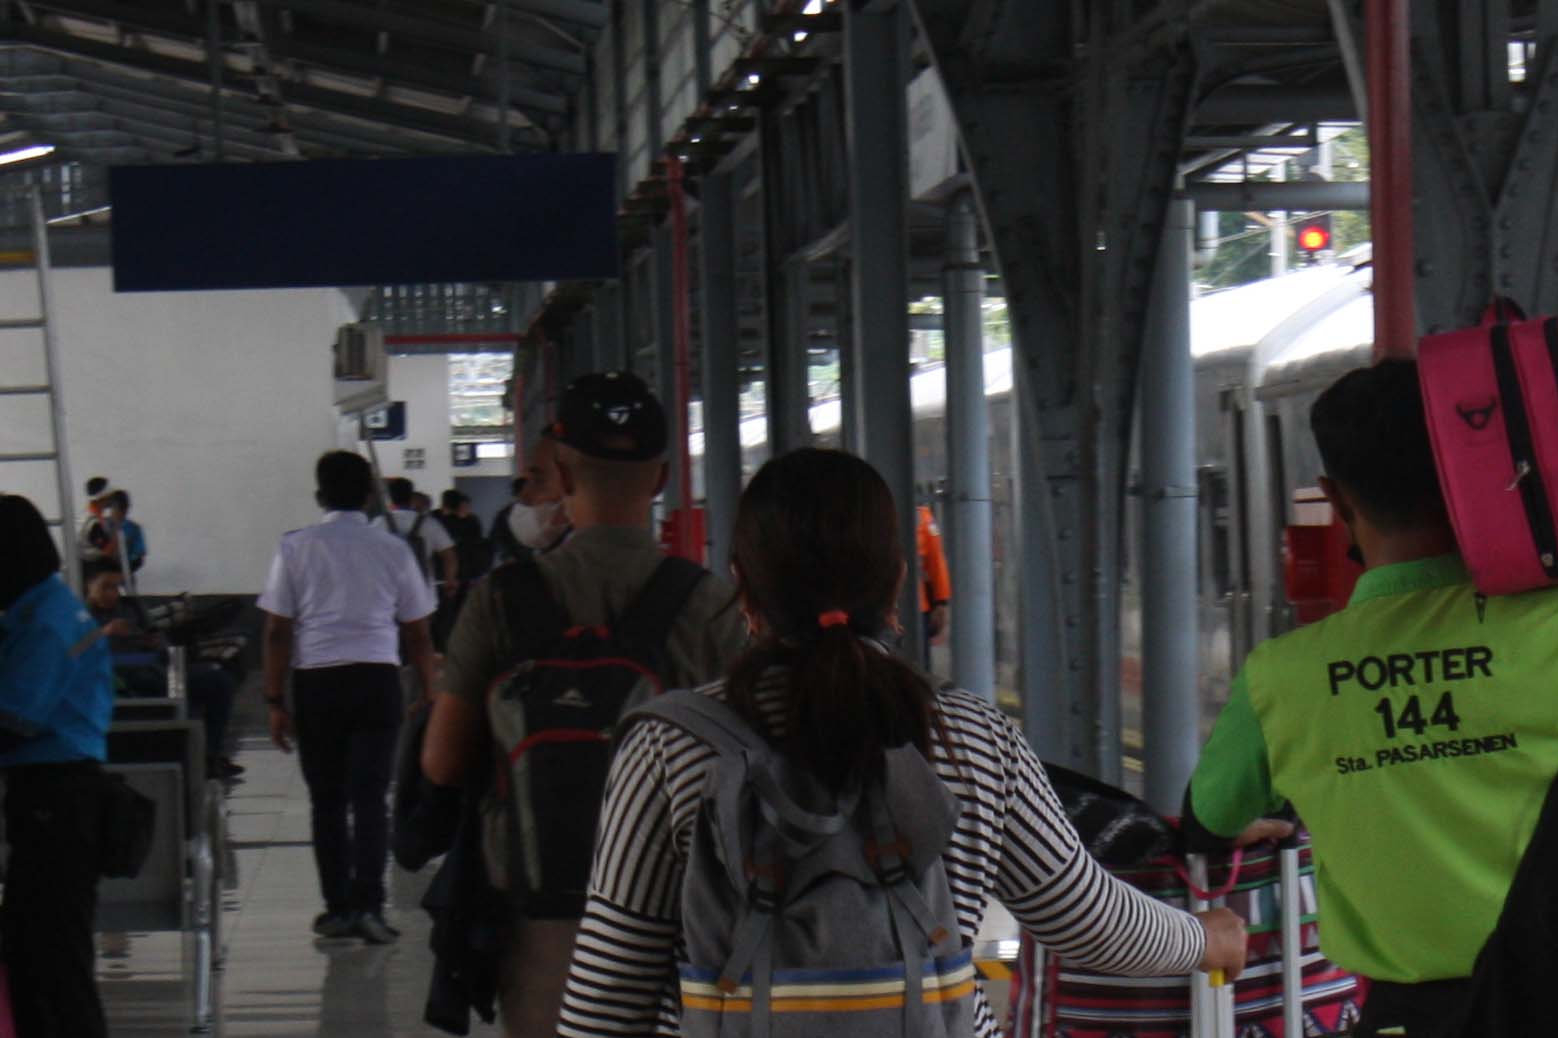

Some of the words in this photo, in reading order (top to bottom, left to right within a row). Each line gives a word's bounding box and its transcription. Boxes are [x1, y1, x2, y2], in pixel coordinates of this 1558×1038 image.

[1328, 646, 1493, 695] PORTER
[1374, 690, 1461, 738] 144
[1335, 755, 1373, 775] Sta.
